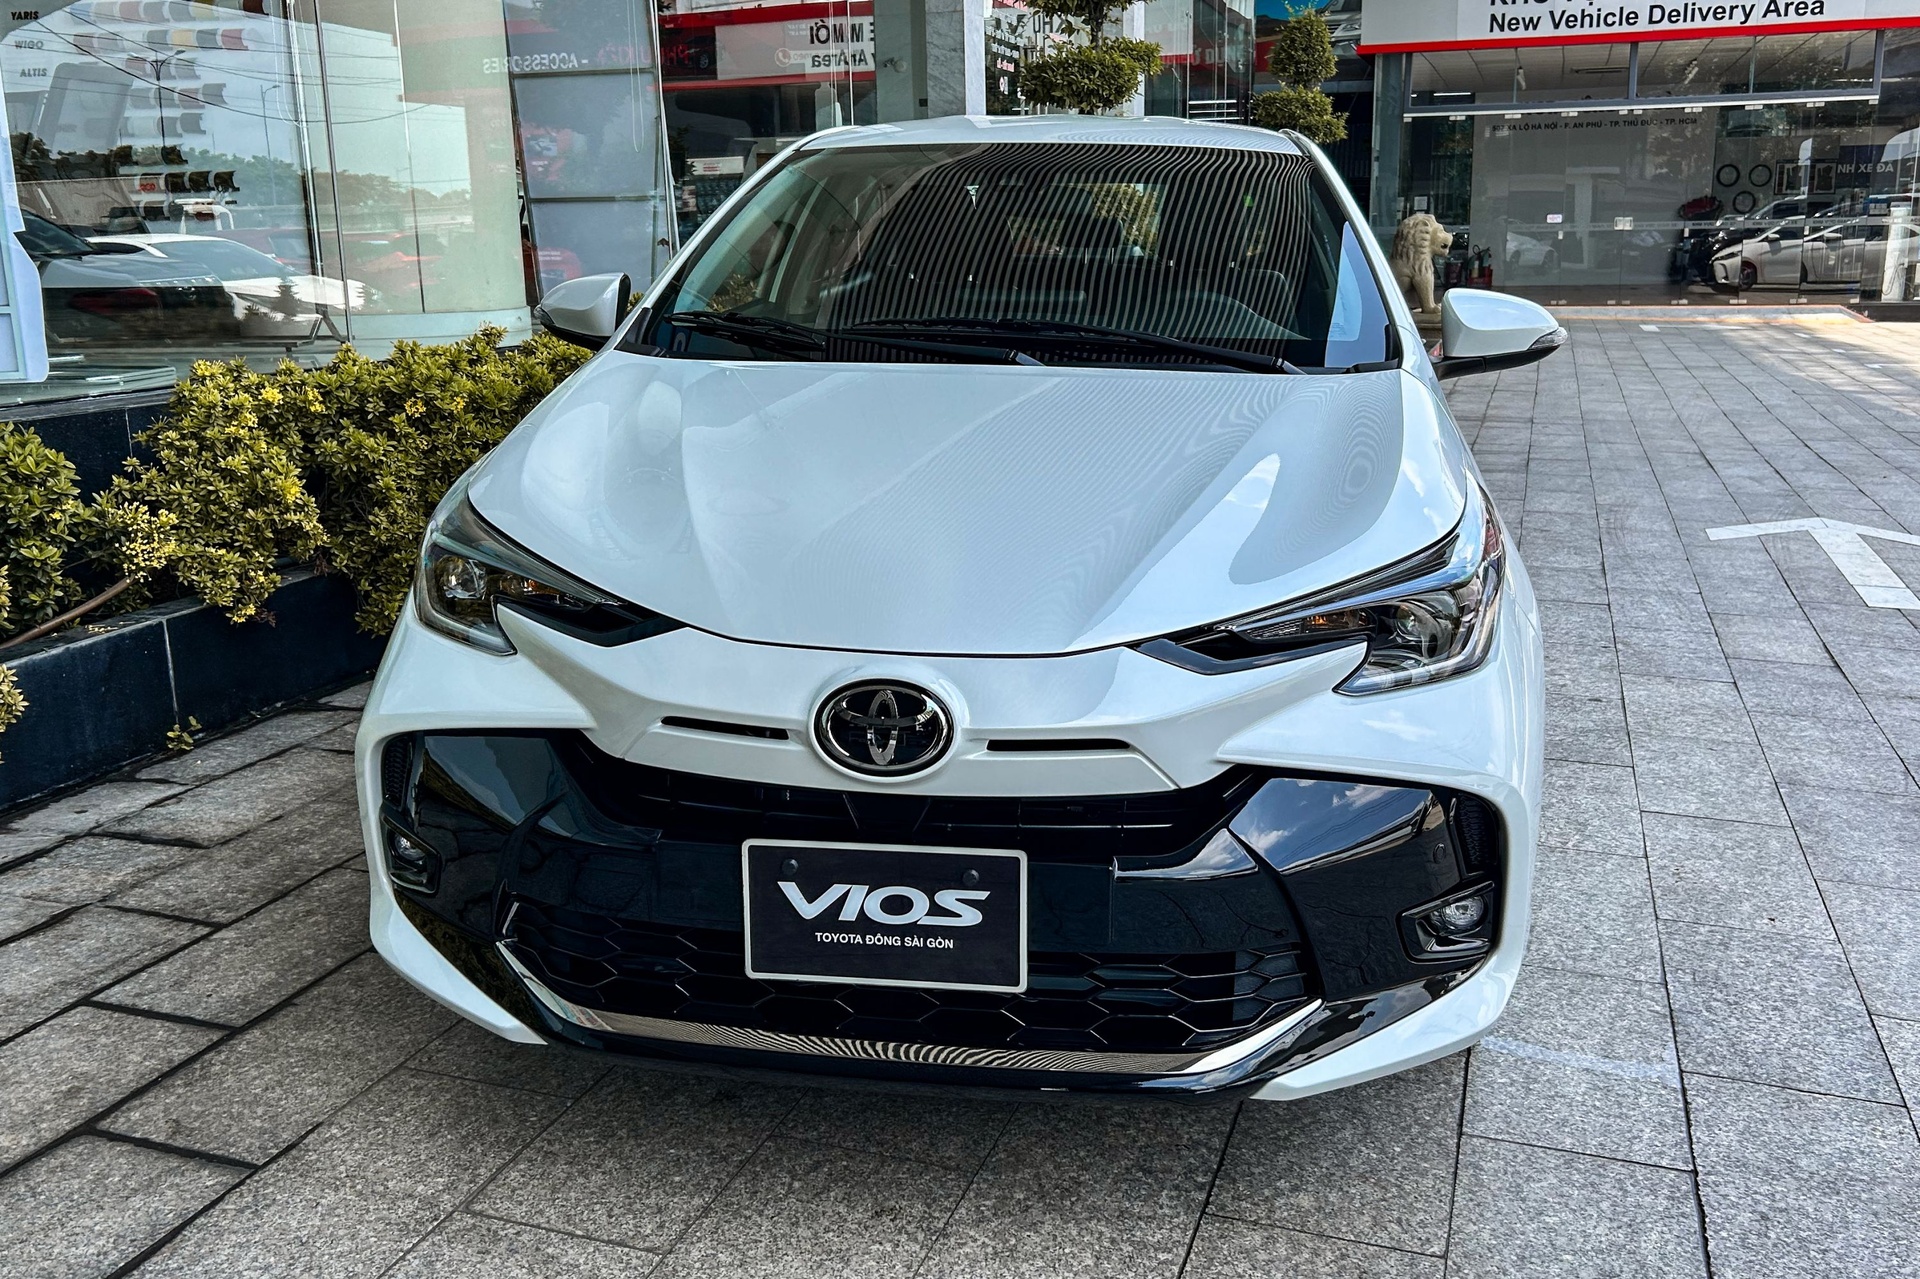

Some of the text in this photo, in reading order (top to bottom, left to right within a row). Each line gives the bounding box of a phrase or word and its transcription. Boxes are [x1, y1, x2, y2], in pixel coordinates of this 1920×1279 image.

[11, 11, 39, 20] YARIS
[1489, 0, 1826, 33] New Vehicle Delivery Area
[15, 40, 44, 49] WIGO
[20, 68, 47, 77] ALTIS
[1858, 163, 1873, 173] XE
[777, 881, 991, 927] VIOS
[815, 932, 954, 949] TOYOTA ĐÔNG SÀI GÒN
